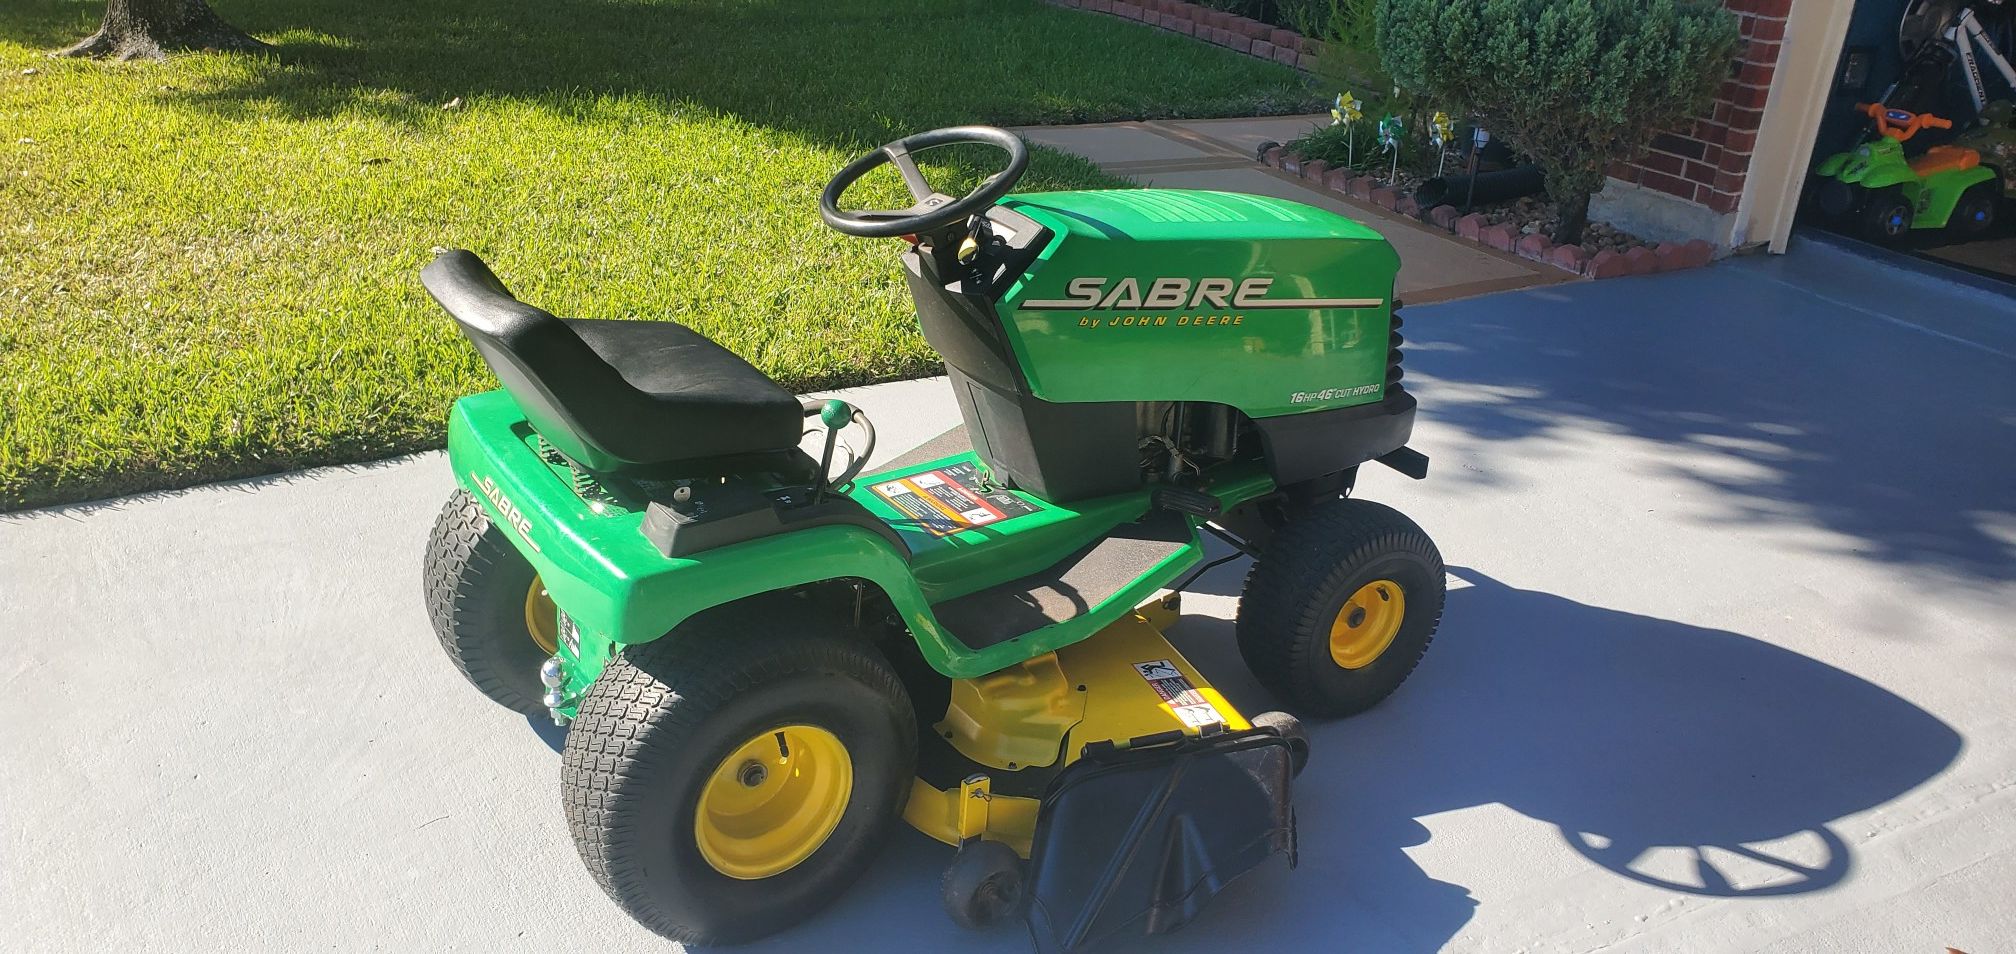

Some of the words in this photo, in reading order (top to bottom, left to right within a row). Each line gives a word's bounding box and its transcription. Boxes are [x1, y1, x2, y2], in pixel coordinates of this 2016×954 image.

[1065, 277, 1274, 310] SABRE
[1078, 315, 1101, 330] by
[1108, 315, 1168, 327] JOHN
[1177, 314, 1245, 327] DEERE
[1352, 383, 1381, 396] HYDRO
[480, 476, 533, 541] SABRE
